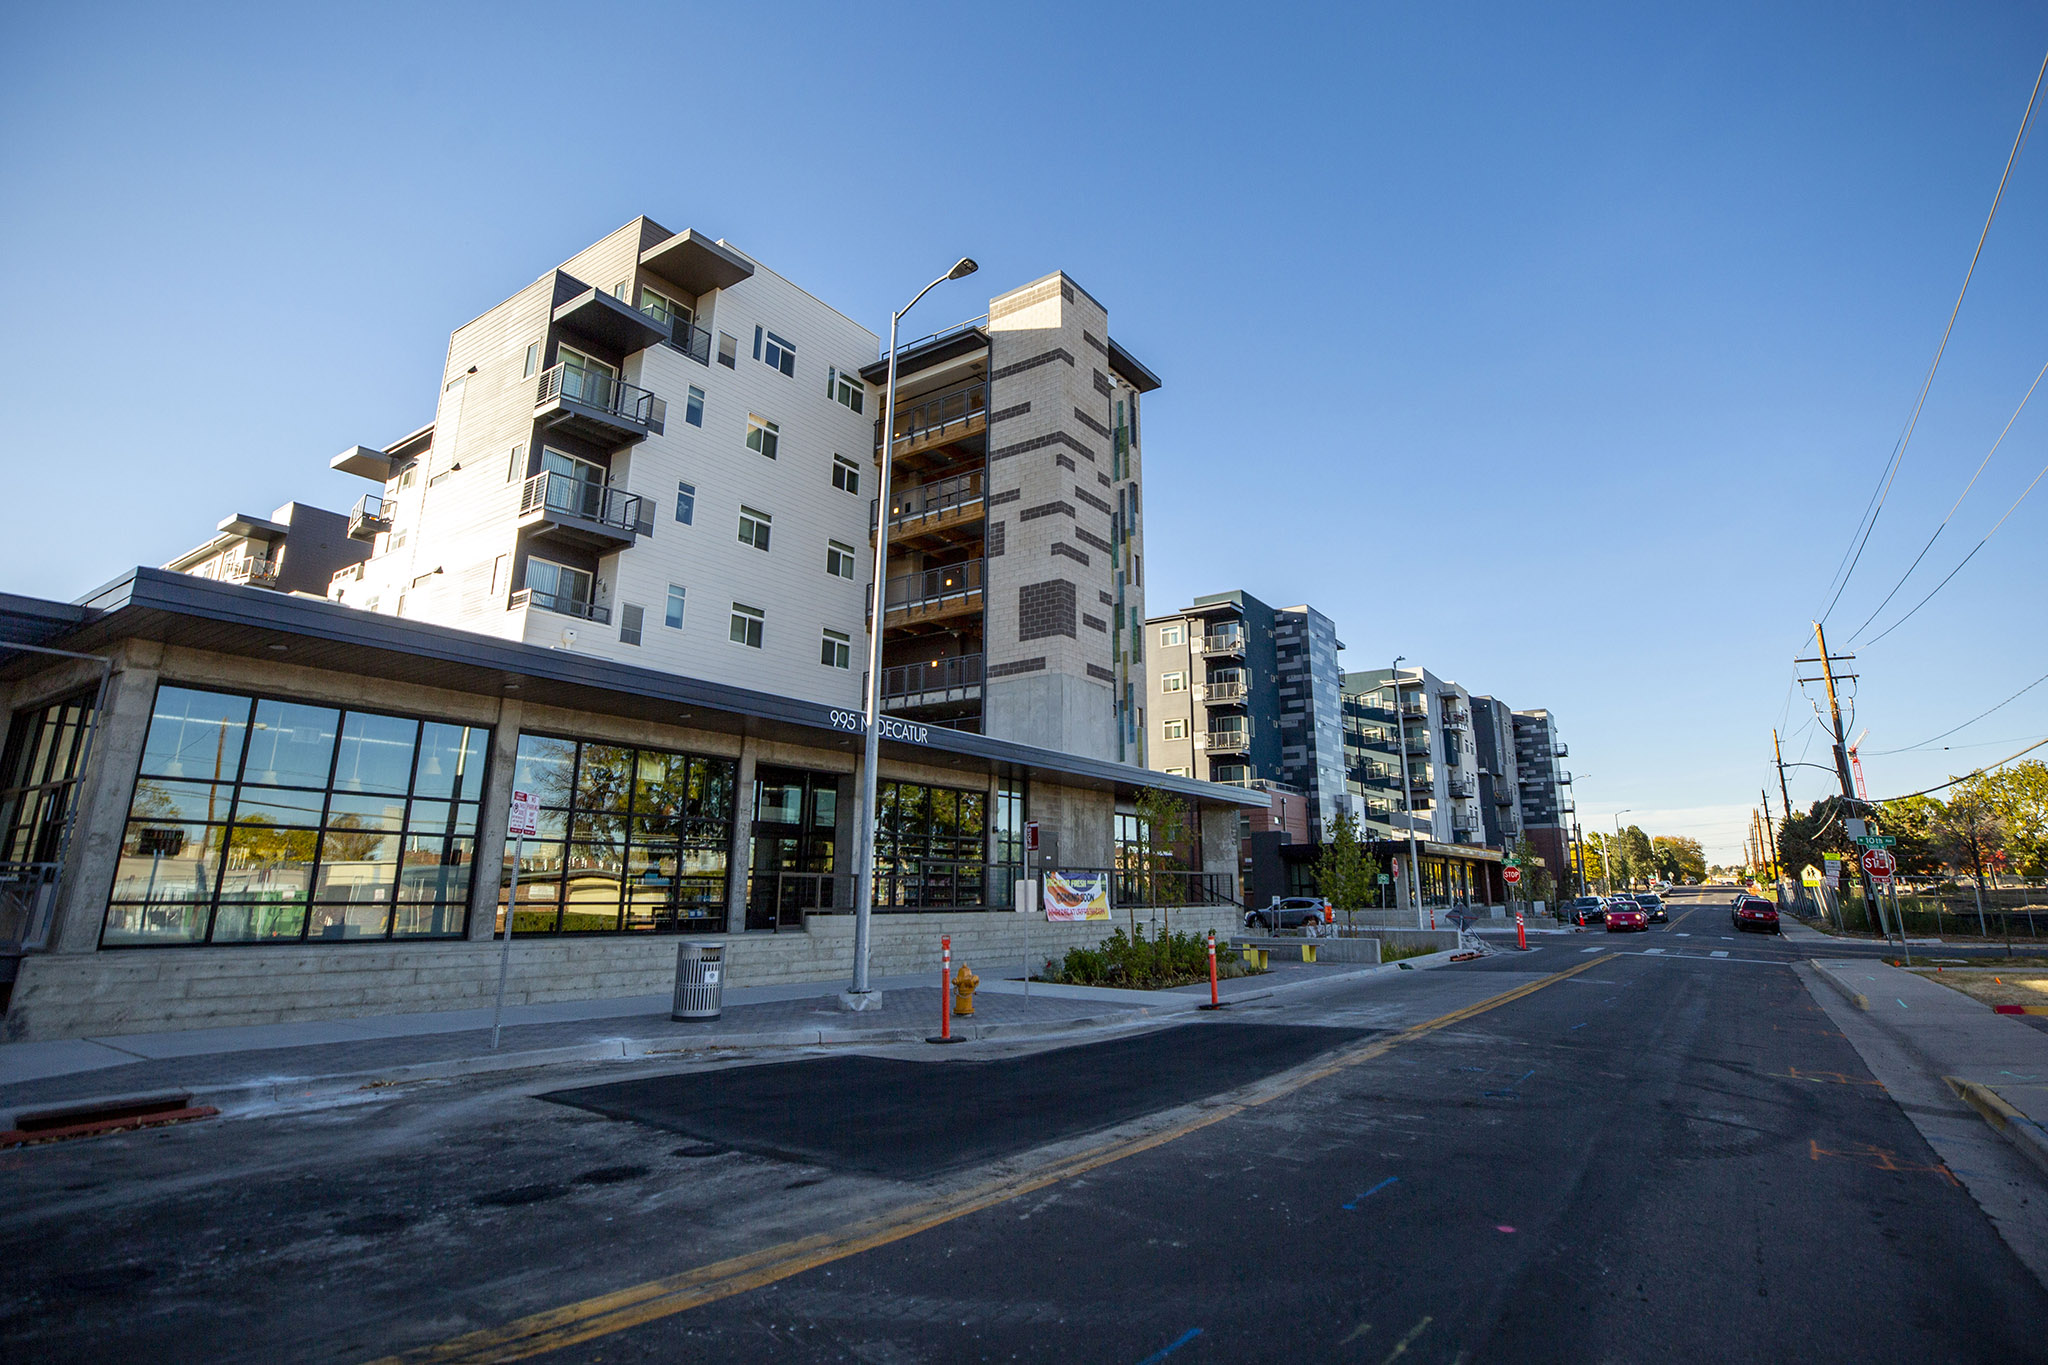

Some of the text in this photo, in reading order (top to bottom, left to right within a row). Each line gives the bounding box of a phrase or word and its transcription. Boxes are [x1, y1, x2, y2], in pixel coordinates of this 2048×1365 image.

[829, 710, 856, 730] 995
[878, 719, 928, 743] DECATUR
[1865, 836, 1884, 845] 10th
[1865, 857, 1892, 868] ST
[1071, 880, 1087, 888] FRESH
[1056, 892, 1095, 902] COMING SOON
